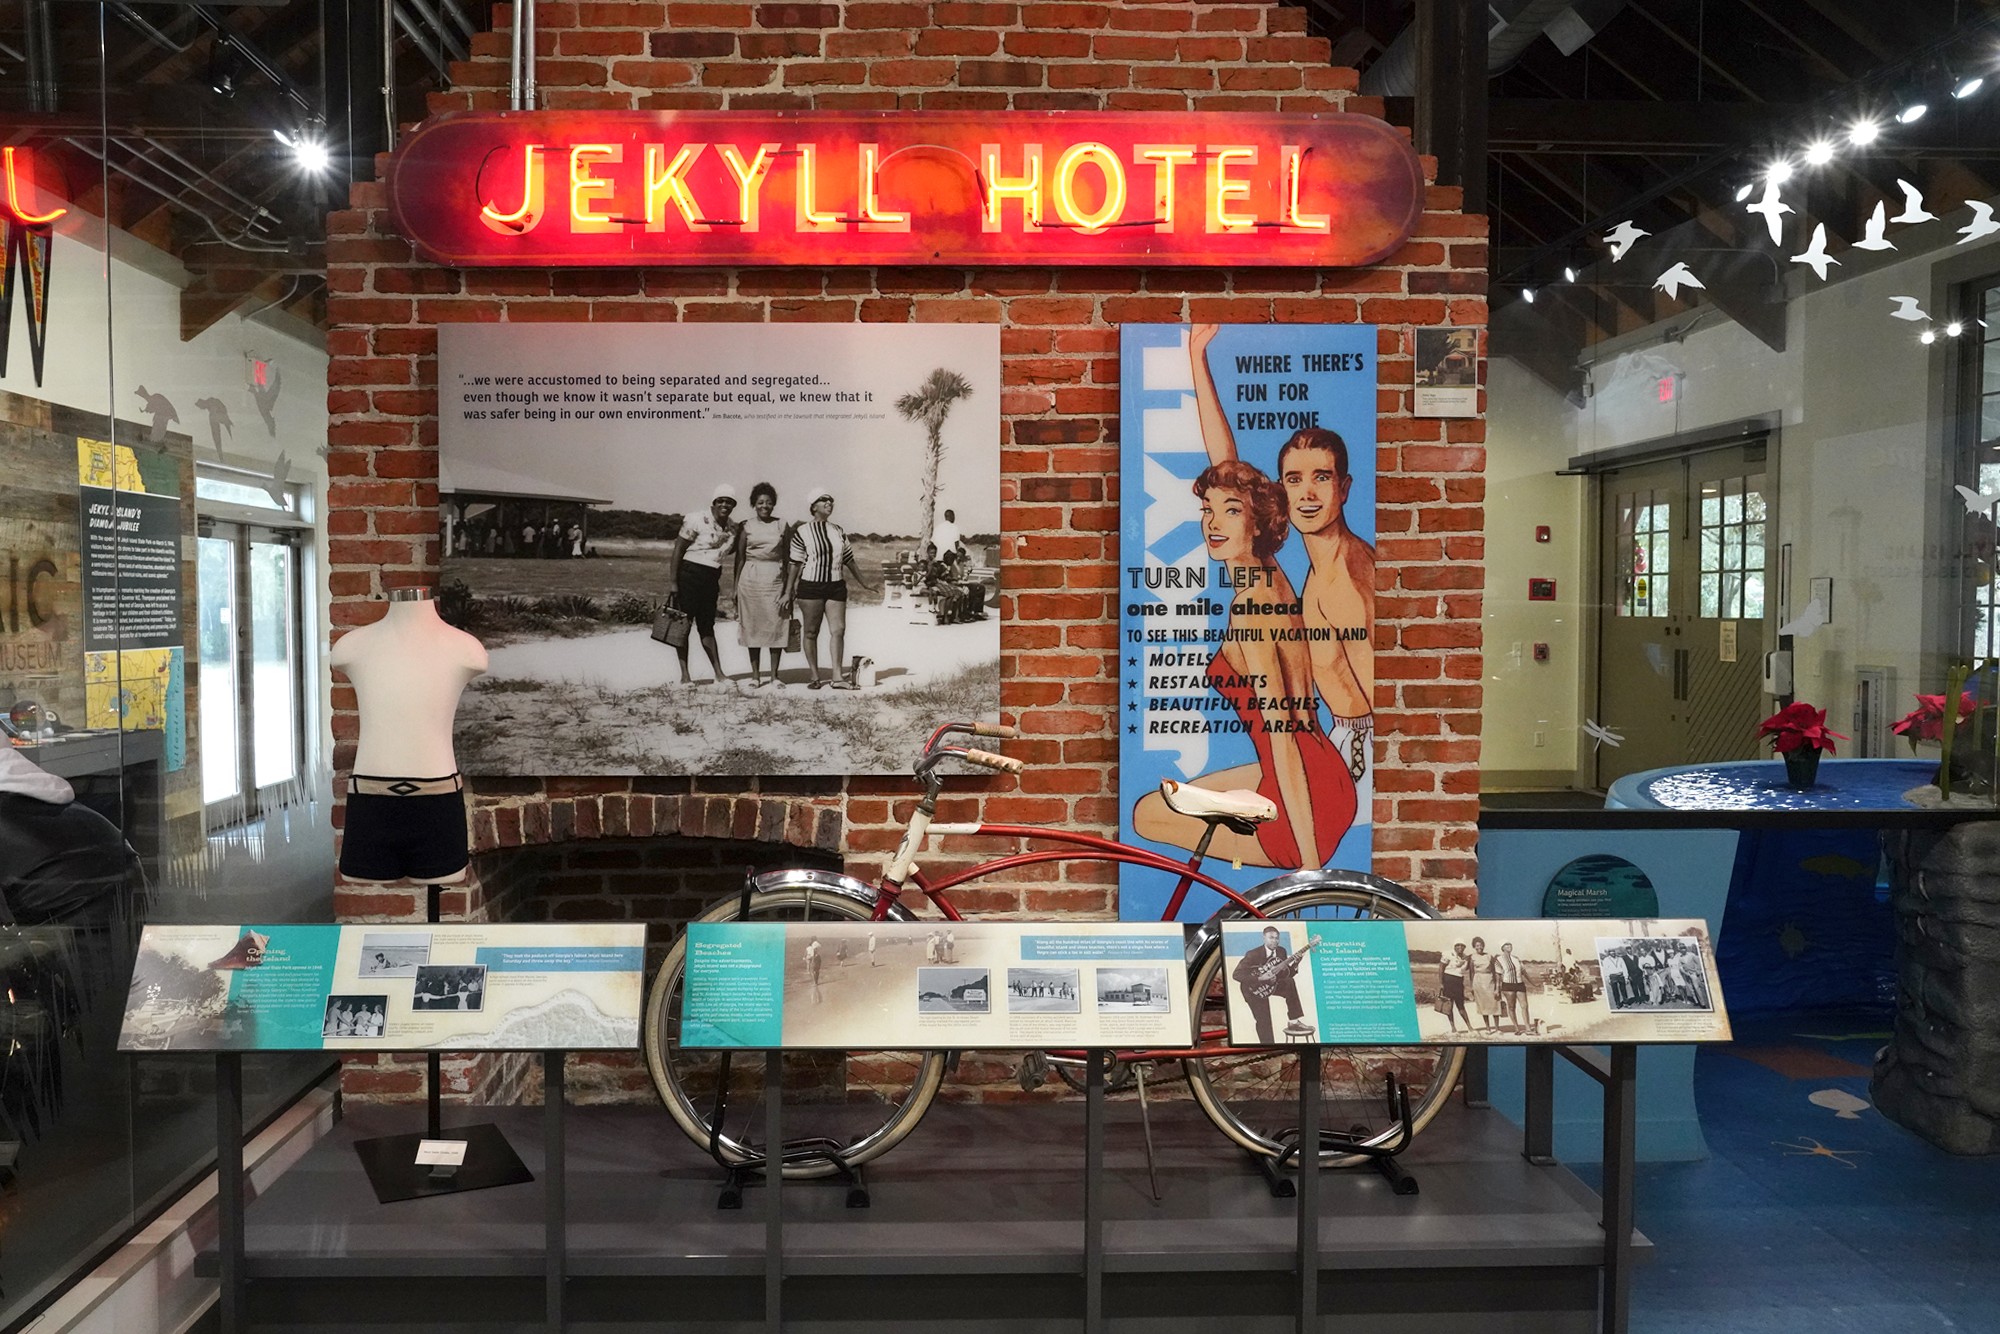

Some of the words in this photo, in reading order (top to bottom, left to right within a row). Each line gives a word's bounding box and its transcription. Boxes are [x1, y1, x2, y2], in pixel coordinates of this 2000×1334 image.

[478, 143, 911, 235] JEKYLL
[979, 142, 1331, 234] HOTEL
[1235, 355, 1292, 374] WHERE
[1302, 353, 1364, 372] THERE'S
[458, 374, 491, 386] "...we
[494, 376, 524, 386] were
[527, 374, 601, 386] accustomed
[605, 375, 618, 386] to
[622, 373, 655, 388] being
[659, 374, 720, 388] separated
[724, 374, 747, 386] and
[751, 374, 830, 388] segregated...
[463, 391, 492, 402] even
[495, 391, 540, 405] though
[542, 394, 560, 402] we
[563, 391, 596, 402] know
[600, 391, 609, 402] it
[612, 391, 652, 402] wasn't
[656, 391, 709, 405] separate
[713, 391, 733, 402] but
[737, 391, 775, 405] equal,
[779, 394, 796, 402] we
[800, 391, 832, 402] knew
[835, 391, 860, 402] that
[864, 391, 873, 402] it
[1236, 384, 1267, 402] FUN
[1279, 383, 1309, 401] FOR
[463, 410, 487, 420] was
[490, 408, 521, 420] safer
[524, 408, 556, 422] being
[560, 408, 571, 420] in
[574, 410, 595, 420] our
[598, 410, 623, 420] own
[626, 408, 710, 420] environment."
[1237, 411, 1319, 430] EVERYONE
[1128, 567, 1206, 589] TURN
[1219, 566, 1278, 588] LEFT
[1127, 601, 1168, 616] one
[1176, 598, 1224, 616] mile
[1232, 598, 1303, 616] ahead
[1127, 630, 1142, 643] TO
[1147, 630, 1167, 643] SEE
[1173, 629, 1198, 643] THIS
[1203, 628, 1264, 643] BEAUTIFUL
[1270, 628, 1330, 642] VACATION
[1335, 628, 1368, 641] LAND
[1149, 652, 1214, 667] MOTELS
[1149, 675, 1268, 689] RESTAURANTS
[1149, 697, 1241, 711] BEAUTIFUL
[1247, 696, 1320, 711] BEACHES
[1149, 720, 1254, 734] RECREATION
[1262, 720, 1316, 734] AREAS
[1558, 889, 1584, 898] Magical
